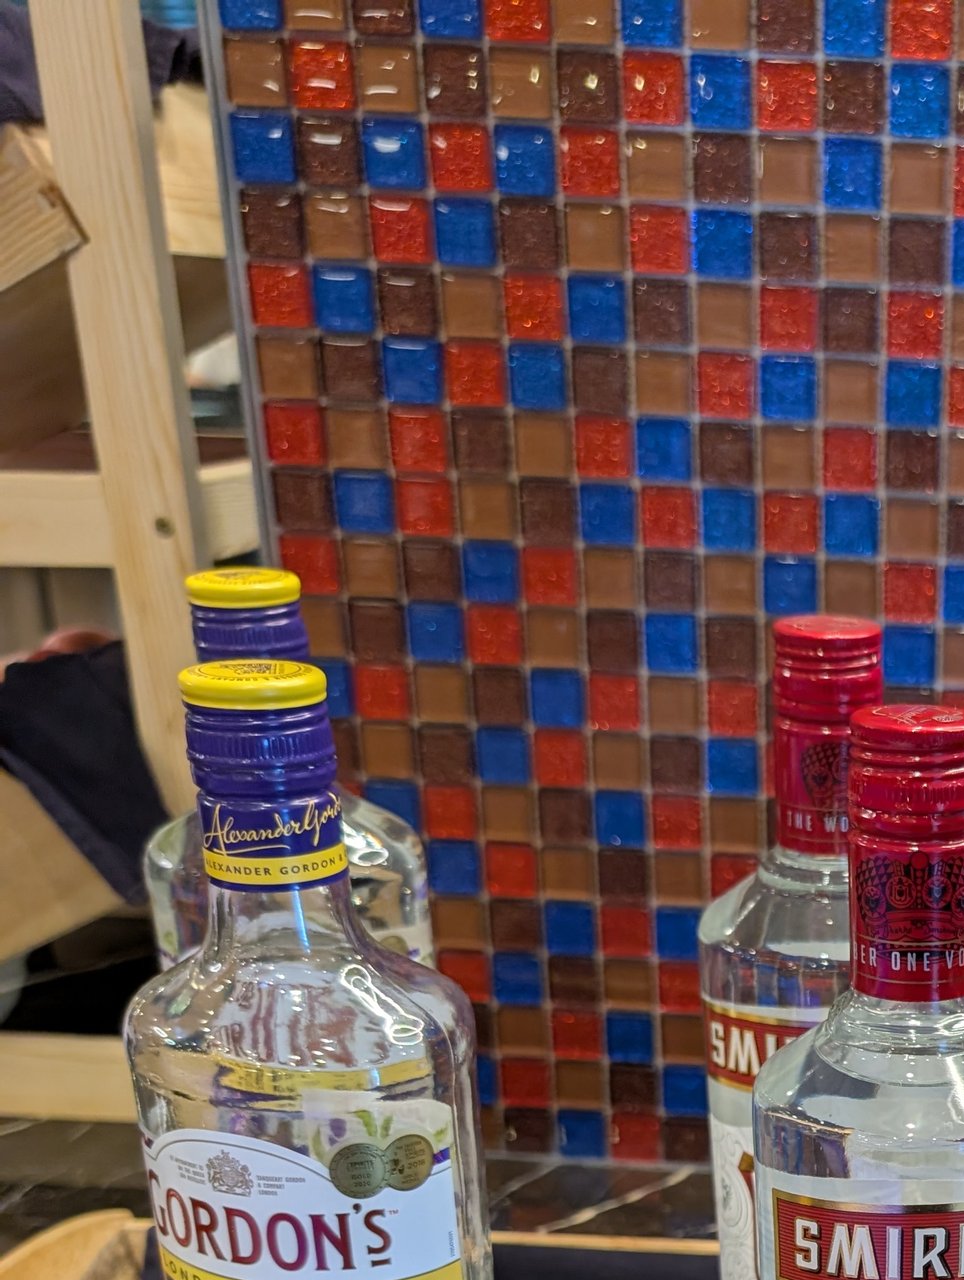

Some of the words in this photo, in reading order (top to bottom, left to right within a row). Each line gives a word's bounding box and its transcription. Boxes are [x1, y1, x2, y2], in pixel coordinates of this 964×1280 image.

[203, 803, 303, 857] Alexander
[280, 857, 336, 875] GORDON
[891, 951, 931, 972] ONE
[710, 1021, 797, 1076] SMI
[148, 1168, 391, 1271] GORDON'S
